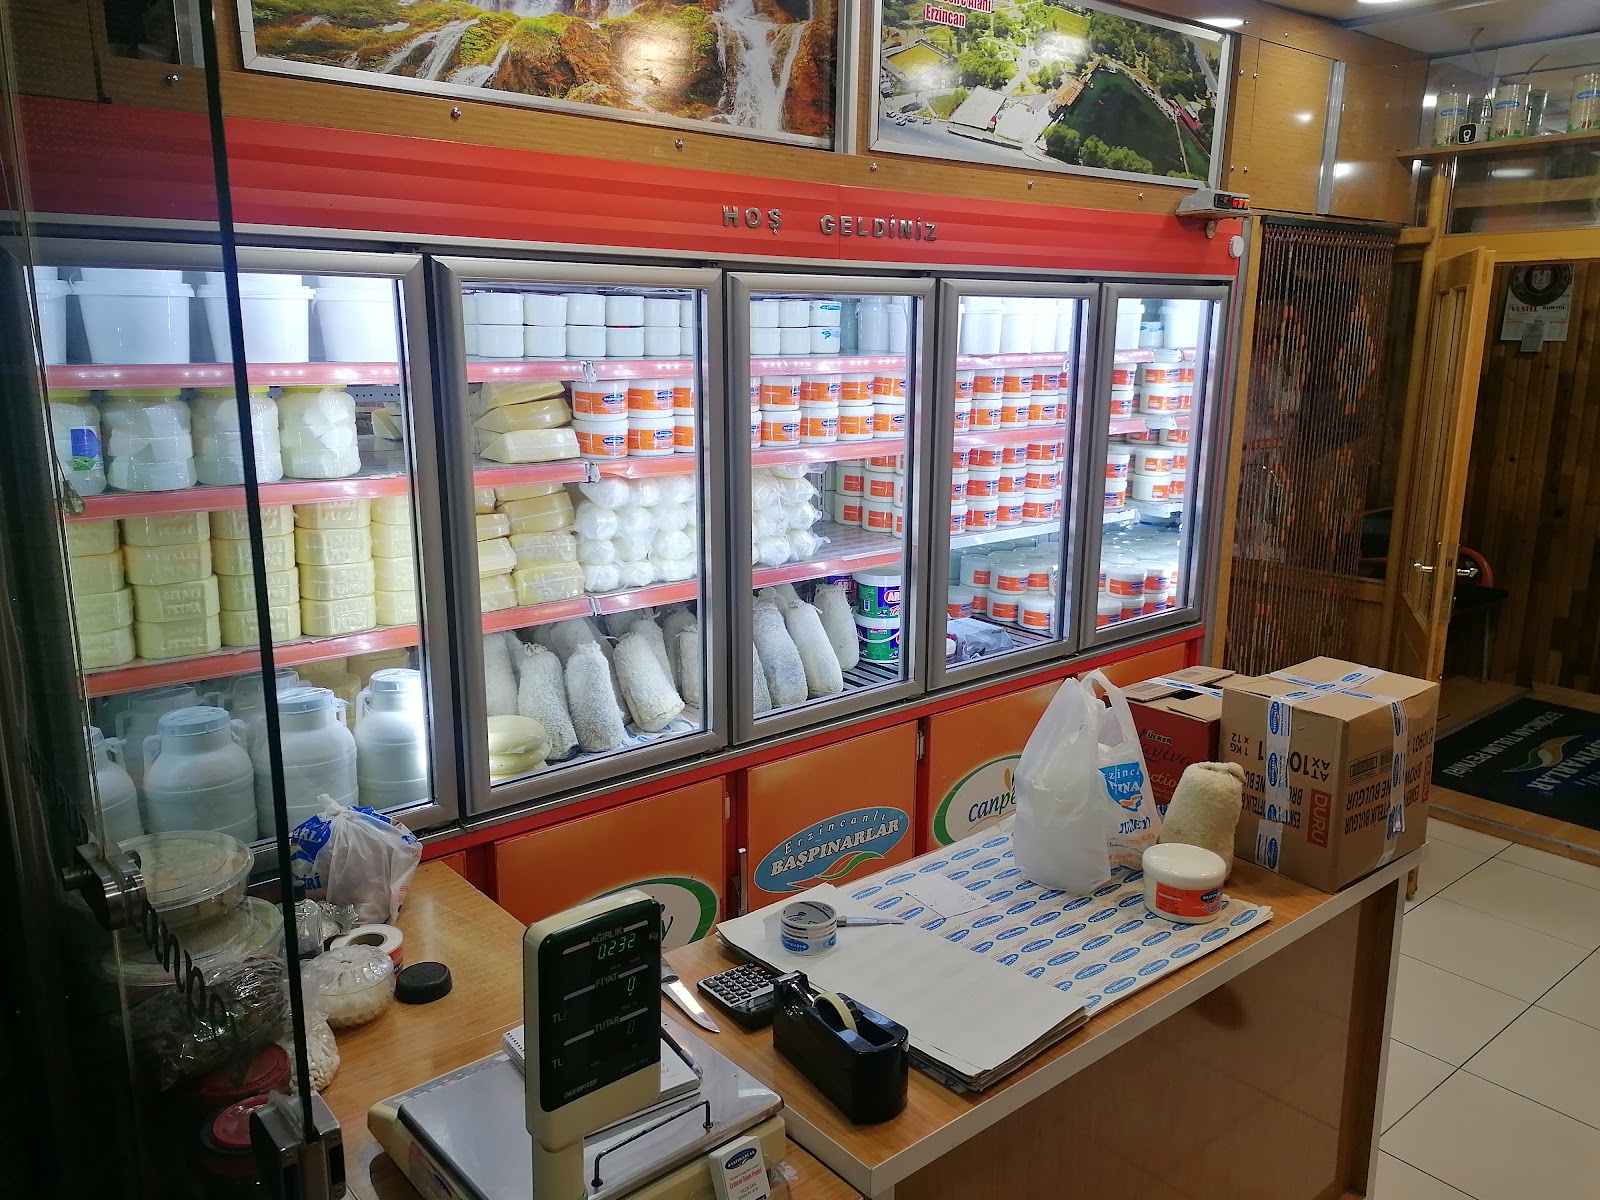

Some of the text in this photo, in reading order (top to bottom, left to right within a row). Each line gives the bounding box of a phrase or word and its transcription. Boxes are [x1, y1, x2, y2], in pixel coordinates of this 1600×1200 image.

[925, 3, 966, 27] Erzincan
[721, 204, 938, 242] HOŞ GELDİNİZ
[1146, 730, 1174, 745] ÜLKER
[1230, 742, 1243, 755] KG
[1480, 734, 1524, 756] TULUM
[1346, 783, 1381, 811] BULGUR
[1310, 793, 1328, 845] DURU
[1344, 809, 1371, 835] BULGUR
[784, 809, 887, 855] Erzincanlı
[770, 818, 900, 877] BAŞPINARLAR
[648, 932, 659, 942] Kg
[595, 972, 619, 988] FİYAT
[594, 1015, 620, 1033] TUTAR
[551, 1058, 564, 1069] TL
